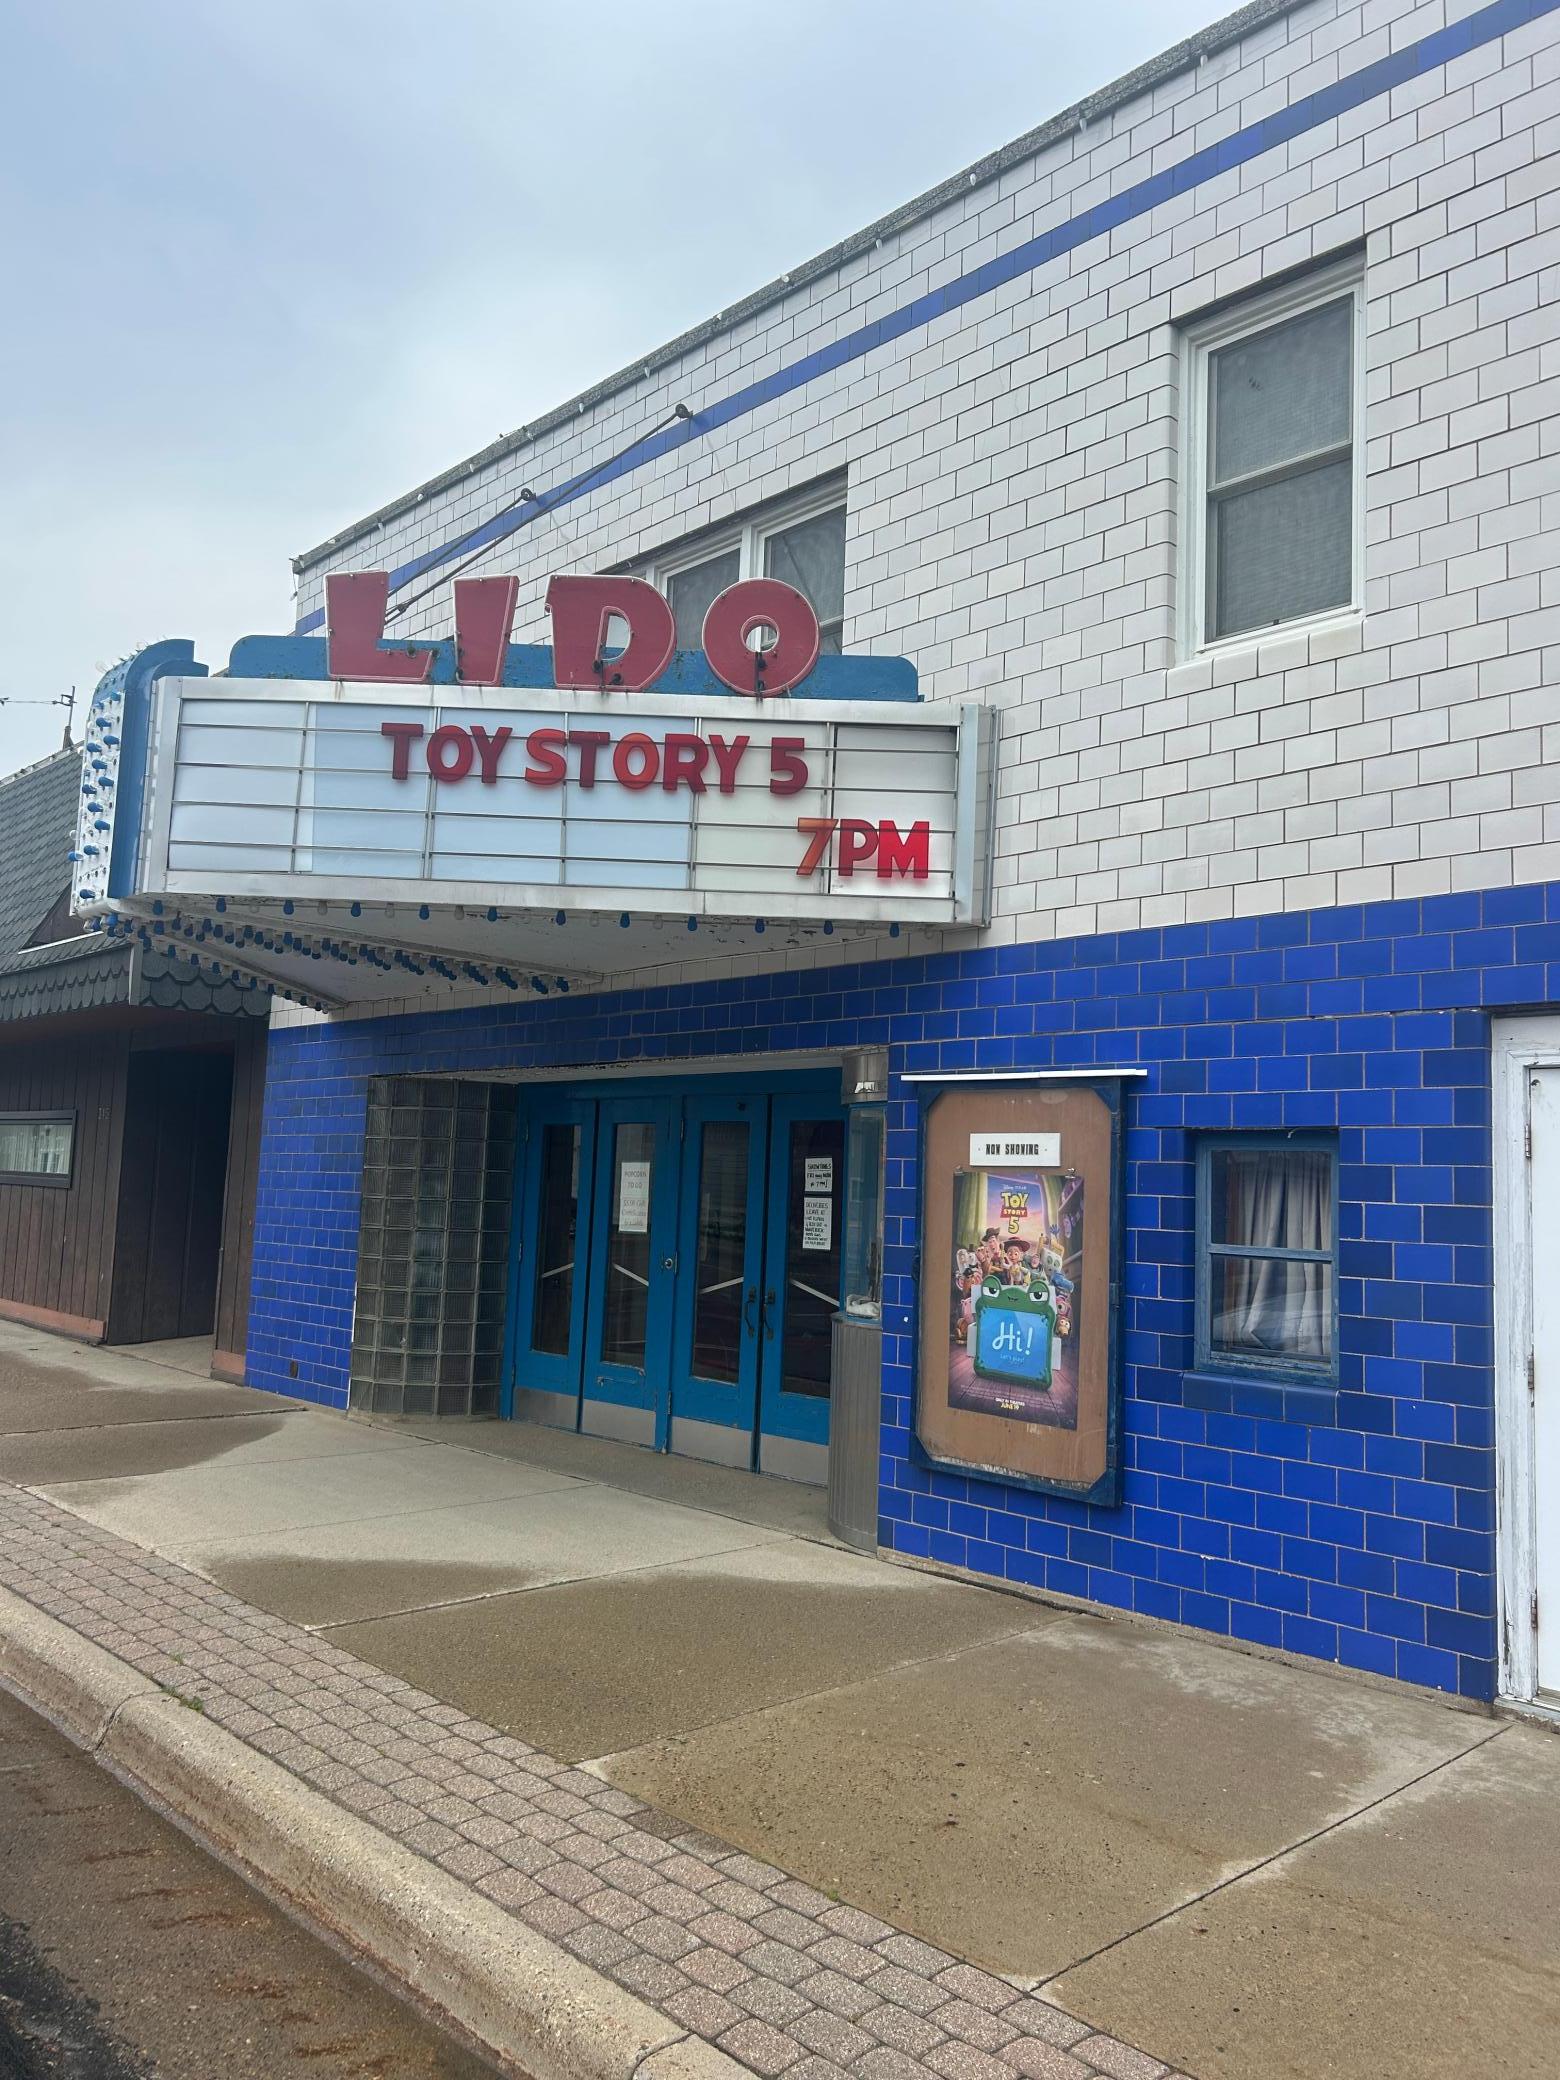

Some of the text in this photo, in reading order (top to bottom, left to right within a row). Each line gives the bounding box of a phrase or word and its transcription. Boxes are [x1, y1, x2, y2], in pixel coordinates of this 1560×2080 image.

[324, 570, 820, 698] LIDO
[381, 723, 809, 795] TOY STORY 5
[796, 817, 930, 879] 7PM
[985, 1143, 1039, 1156] NOW SHOWING
[1001, 1191, 1029, 1209] TOY
[1003, 1208, 1026, 1216] STORY
[1008, 1216, 1020, 1234] 5
[992, 1321, 1033, 1356] Hi!
